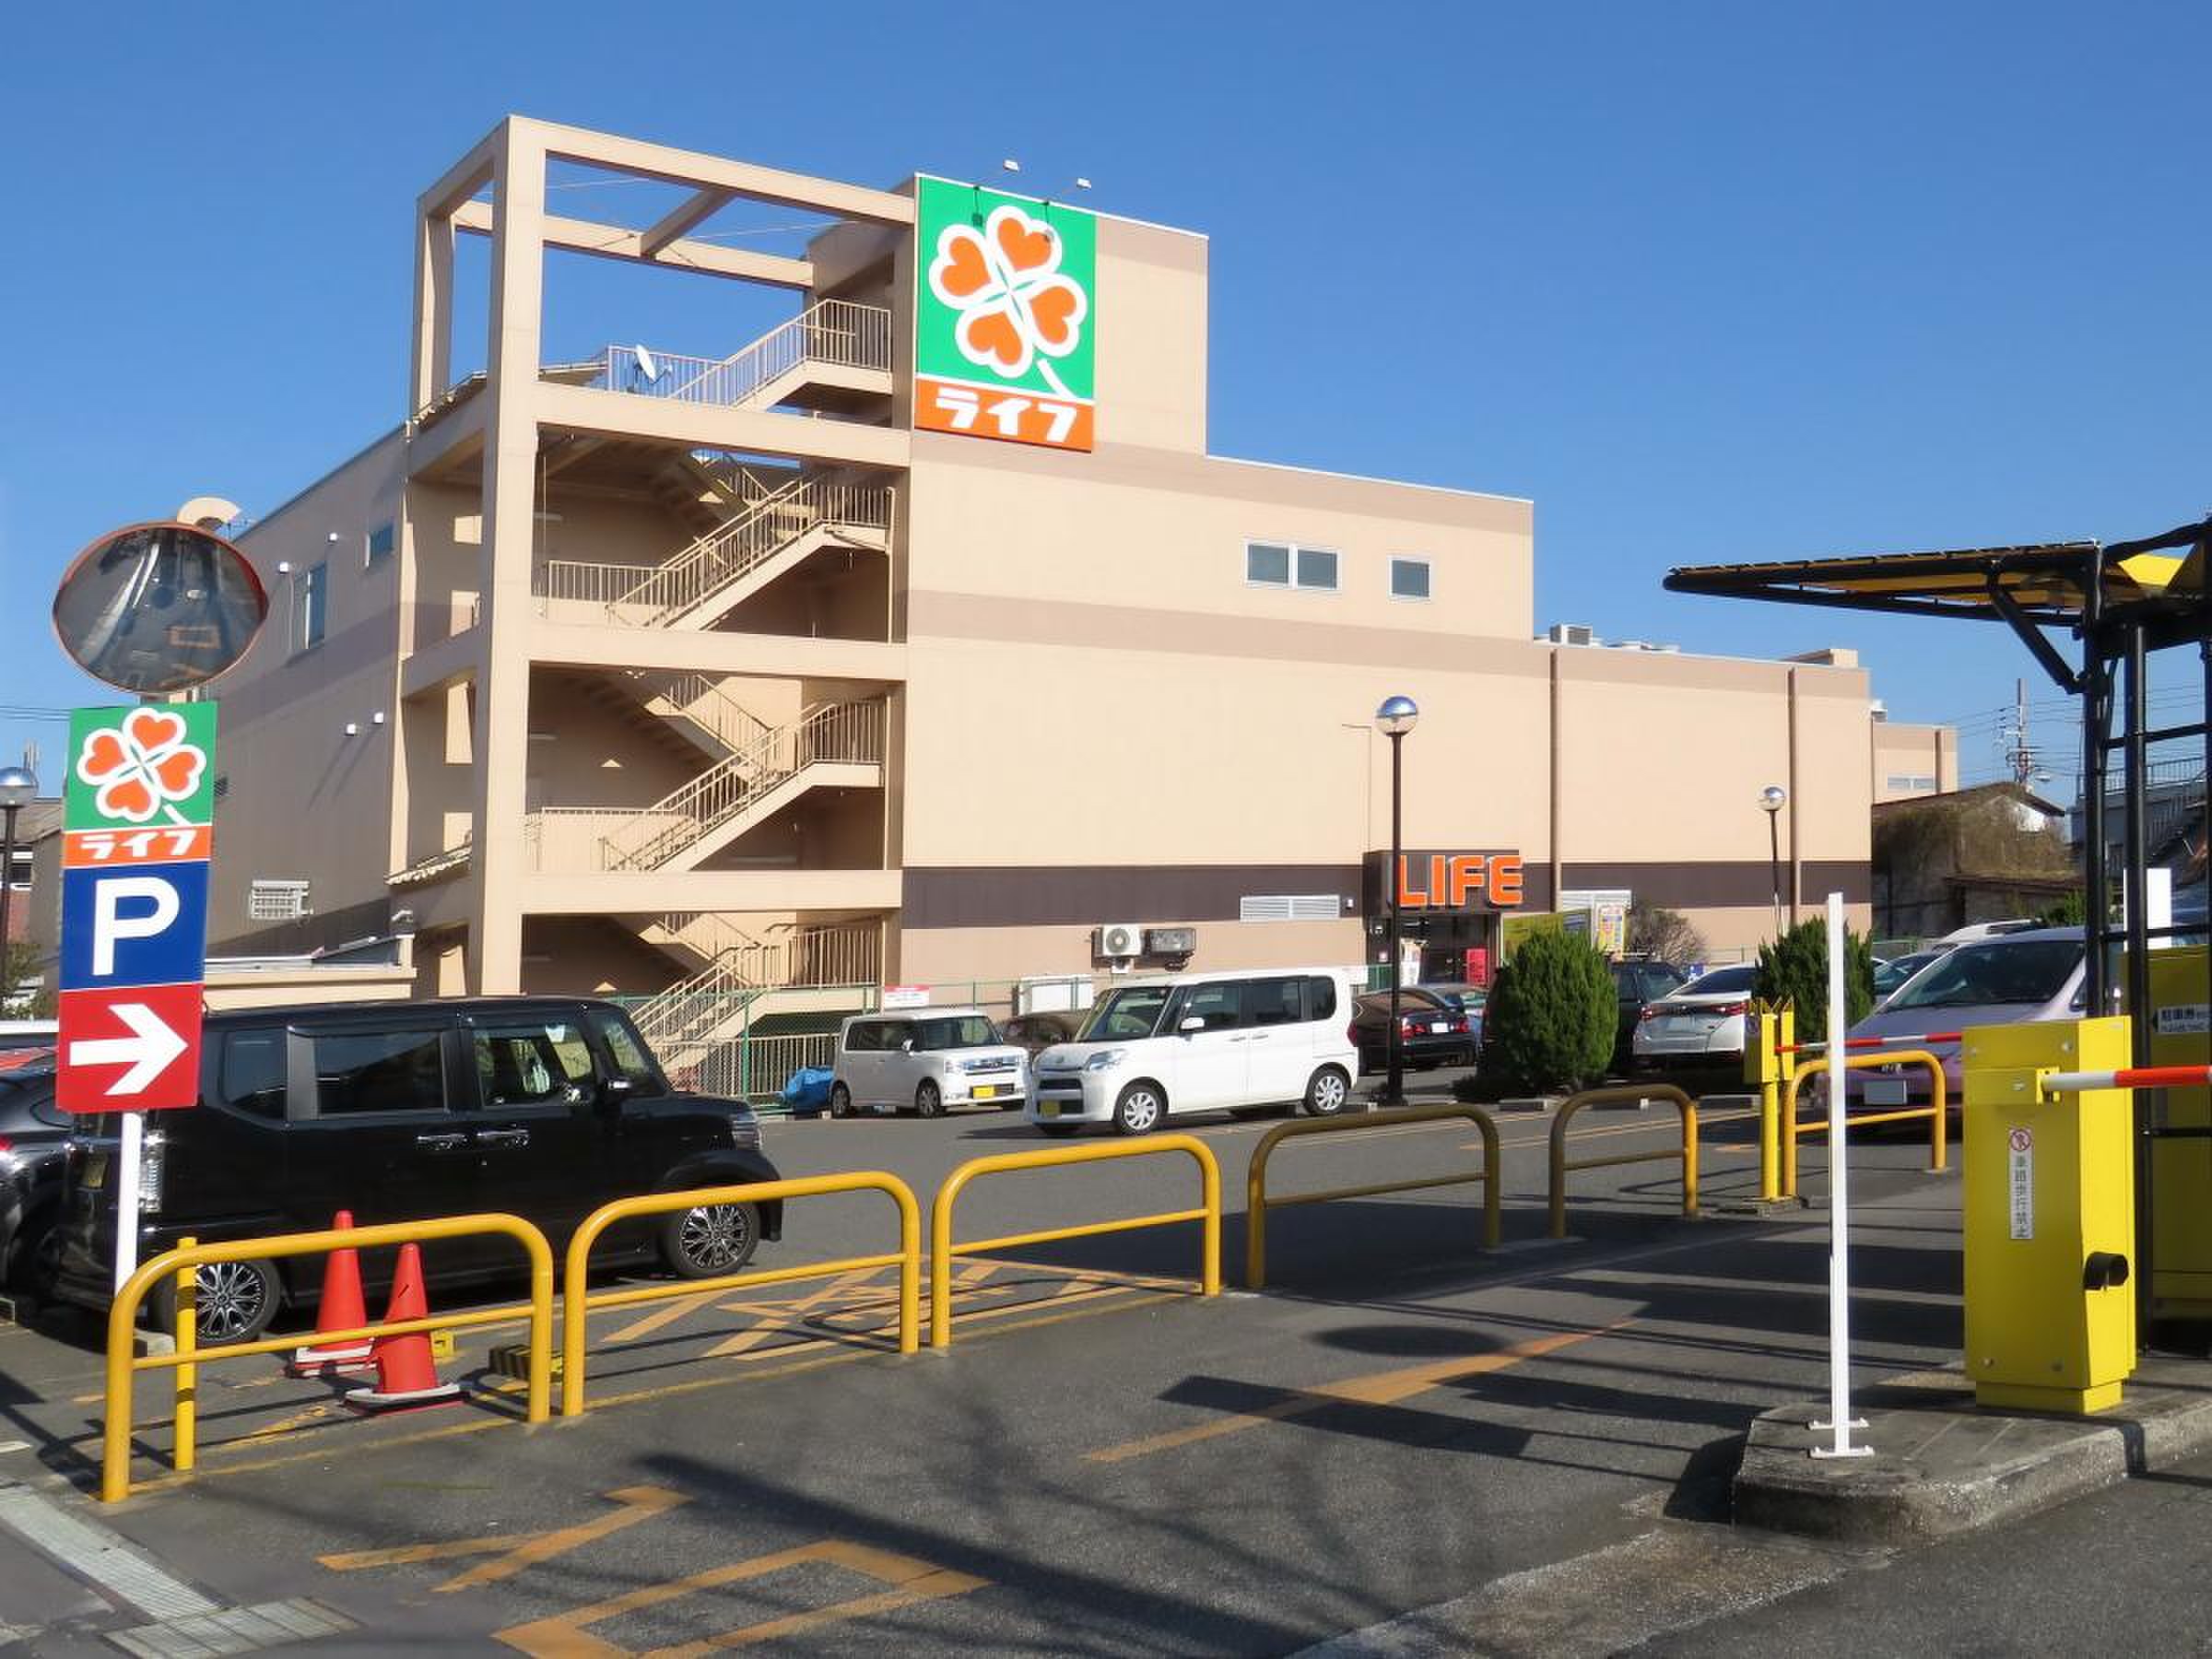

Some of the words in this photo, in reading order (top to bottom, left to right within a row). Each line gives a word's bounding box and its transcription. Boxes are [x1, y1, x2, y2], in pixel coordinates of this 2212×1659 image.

[935, 387, 1077, 442] ライフ
[80, 830, 197, 859] ライフ
[1399, 854, 1524, 907] LIFE
[92, 877, 180, 976] P
